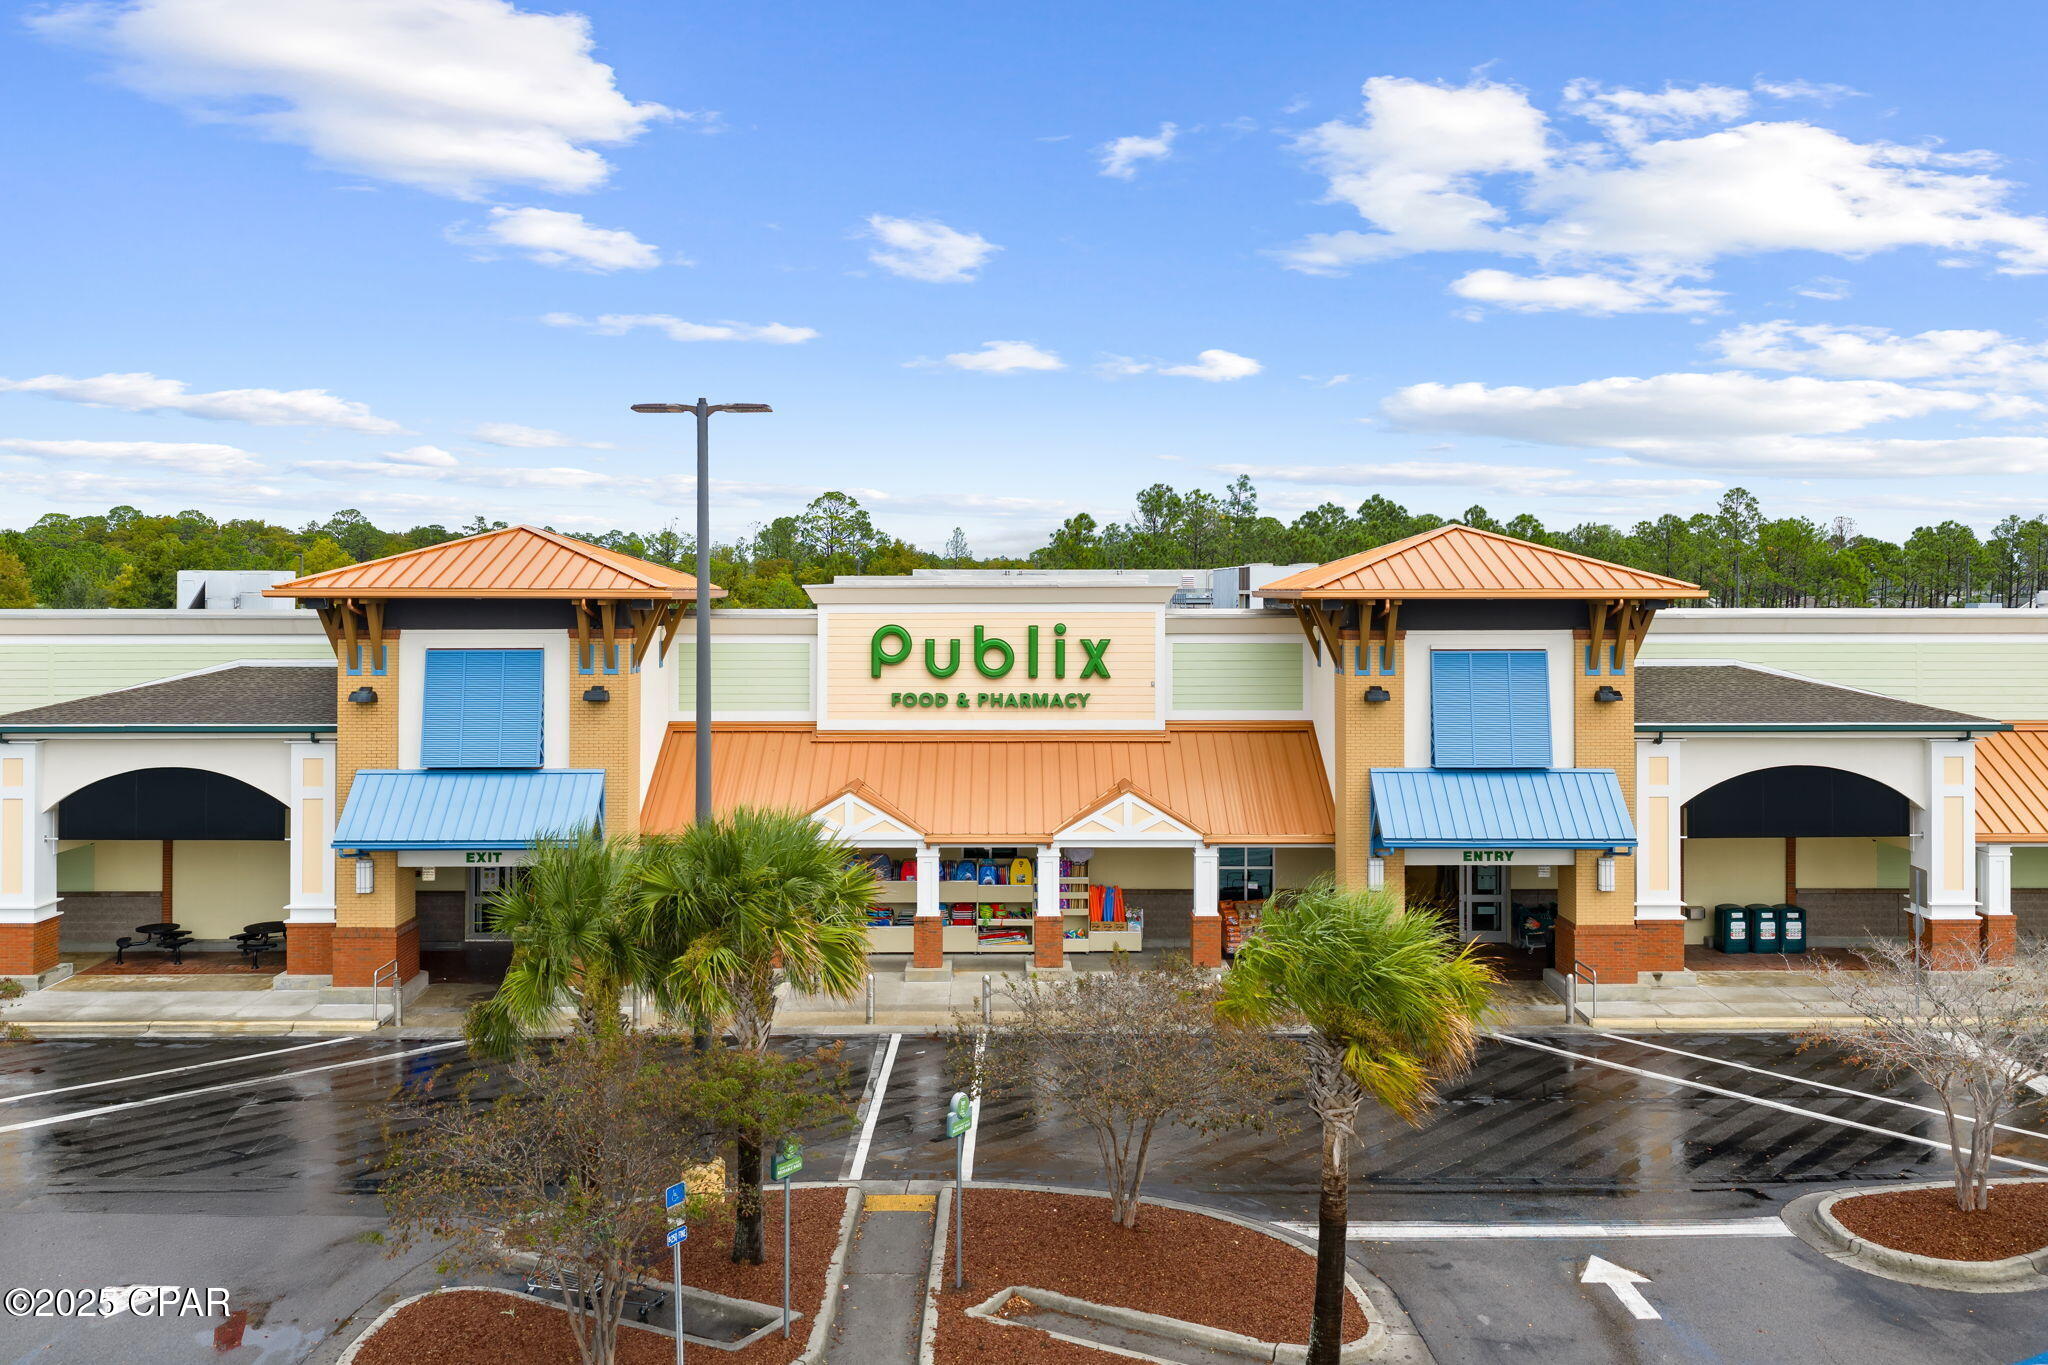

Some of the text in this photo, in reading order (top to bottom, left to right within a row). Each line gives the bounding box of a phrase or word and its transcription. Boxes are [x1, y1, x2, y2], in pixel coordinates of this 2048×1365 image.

[871, 623, 1111, 679] Publix
[891, 692, 1091, 708] FOOD & PHARMACY
[466, 852, 502, 863] EXIT
[1463, 851, 1514, 861] ENTRY
